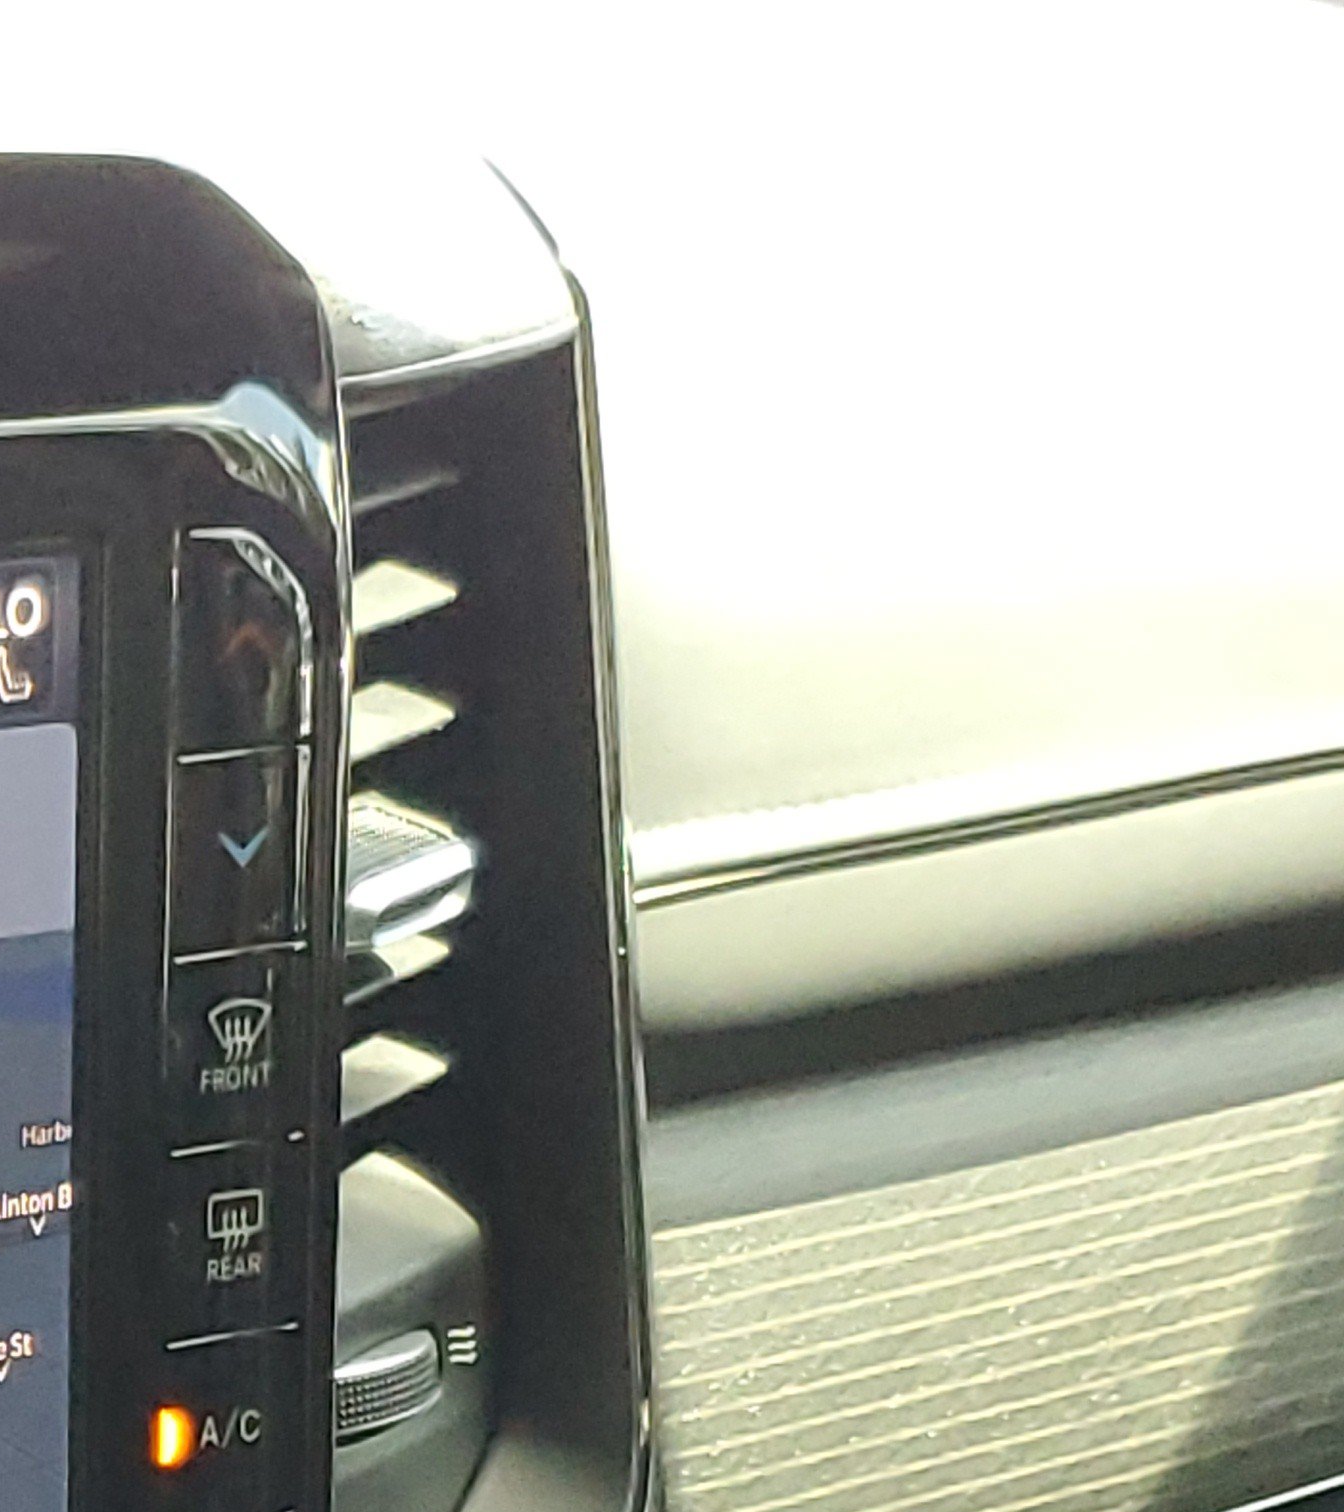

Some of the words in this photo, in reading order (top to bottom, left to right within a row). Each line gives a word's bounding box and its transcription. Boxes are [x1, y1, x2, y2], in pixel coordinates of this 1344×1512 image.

[200, 1060, 272, 1094] FRONT
[207, 1253, 262, 1283] REAR
[10, 1333, 33, 1358] St
[200, 1407, 261, 1449] A/C
